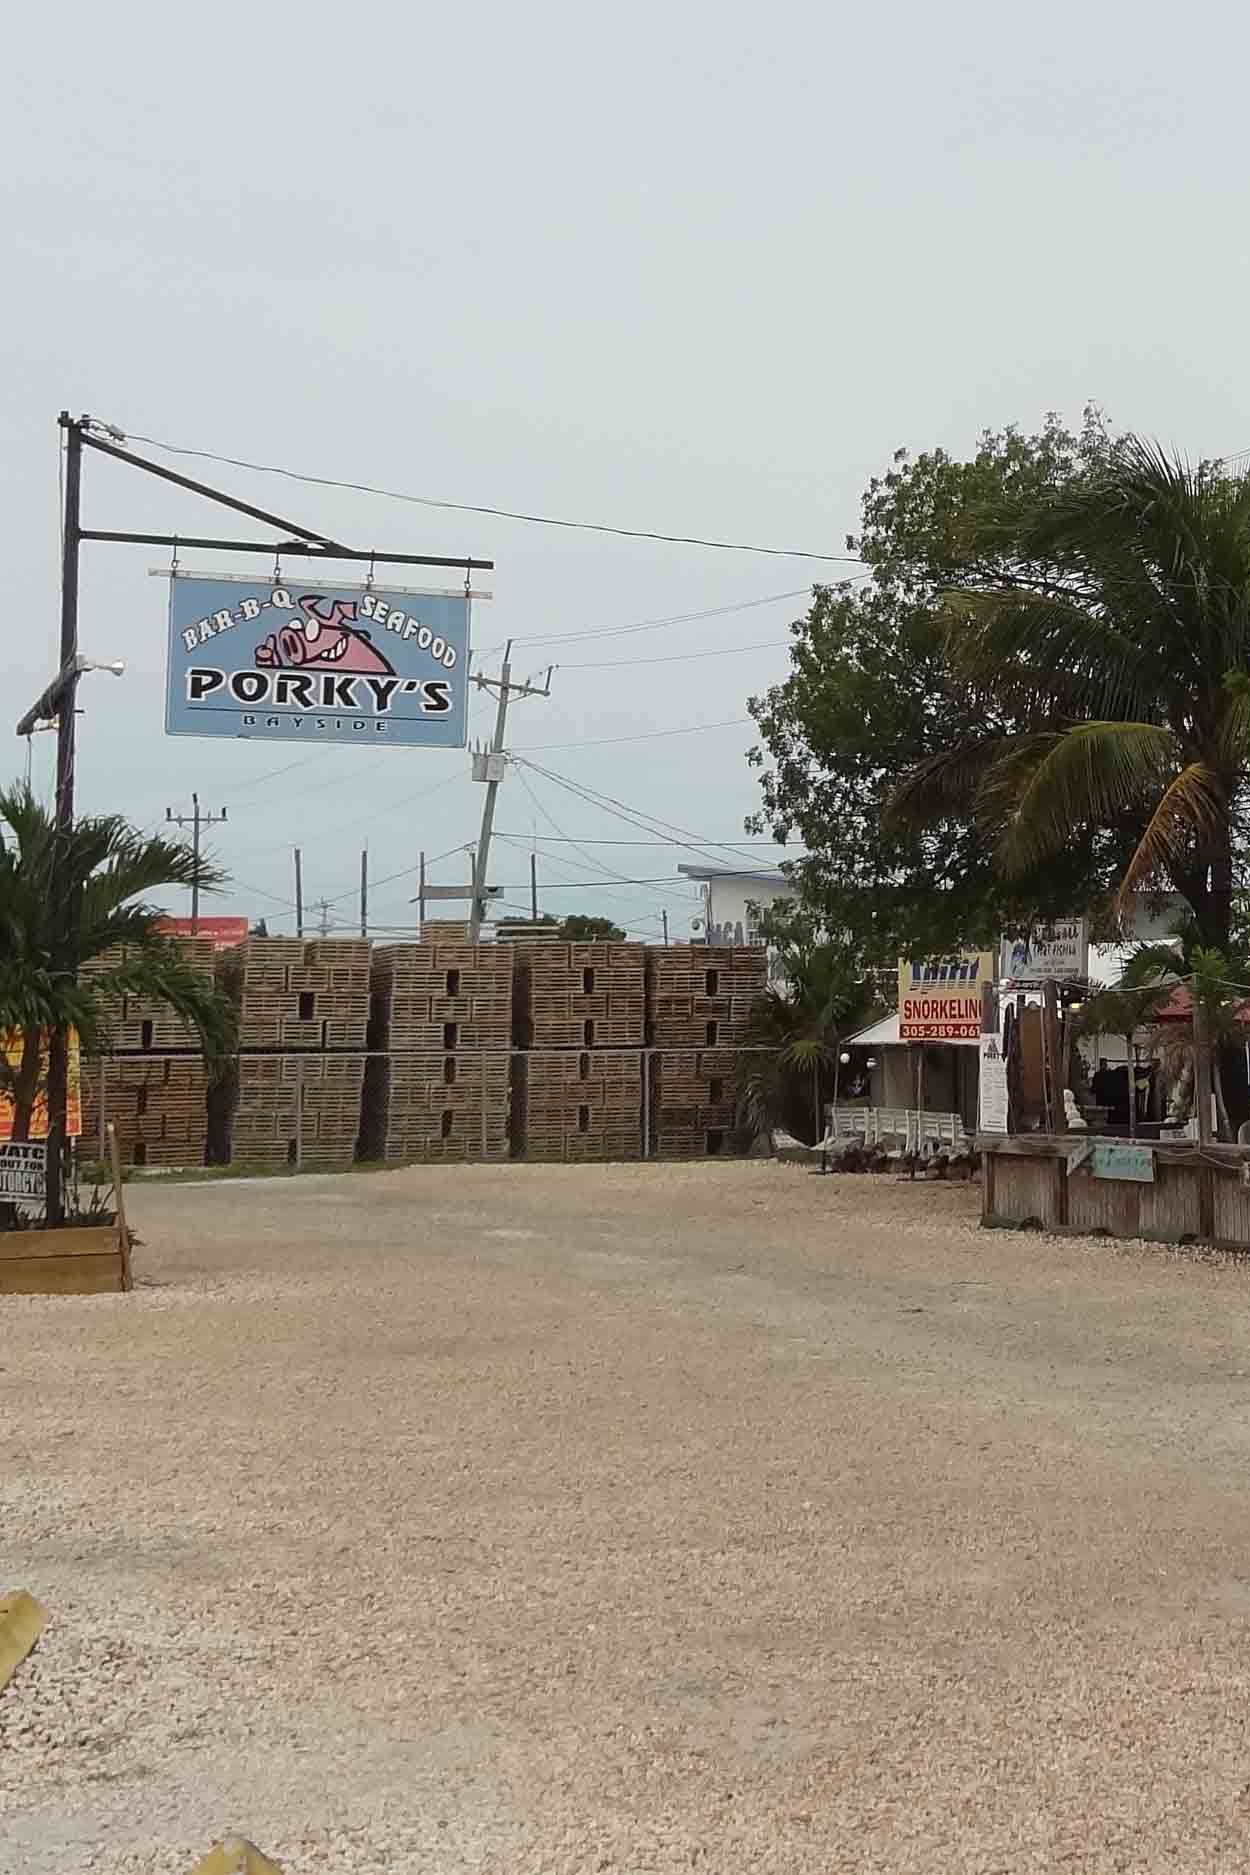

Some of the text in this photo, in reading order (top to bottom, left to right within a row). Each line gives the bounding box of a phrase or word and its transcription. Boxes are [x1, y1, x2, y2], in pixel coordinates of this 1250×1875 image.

[180, 587, 457, 669] BAR-B-Q SEAFOOD
[184, 667, 452, 714] PORKY'S
[243, 715, 388, 732] BAYSIDE
